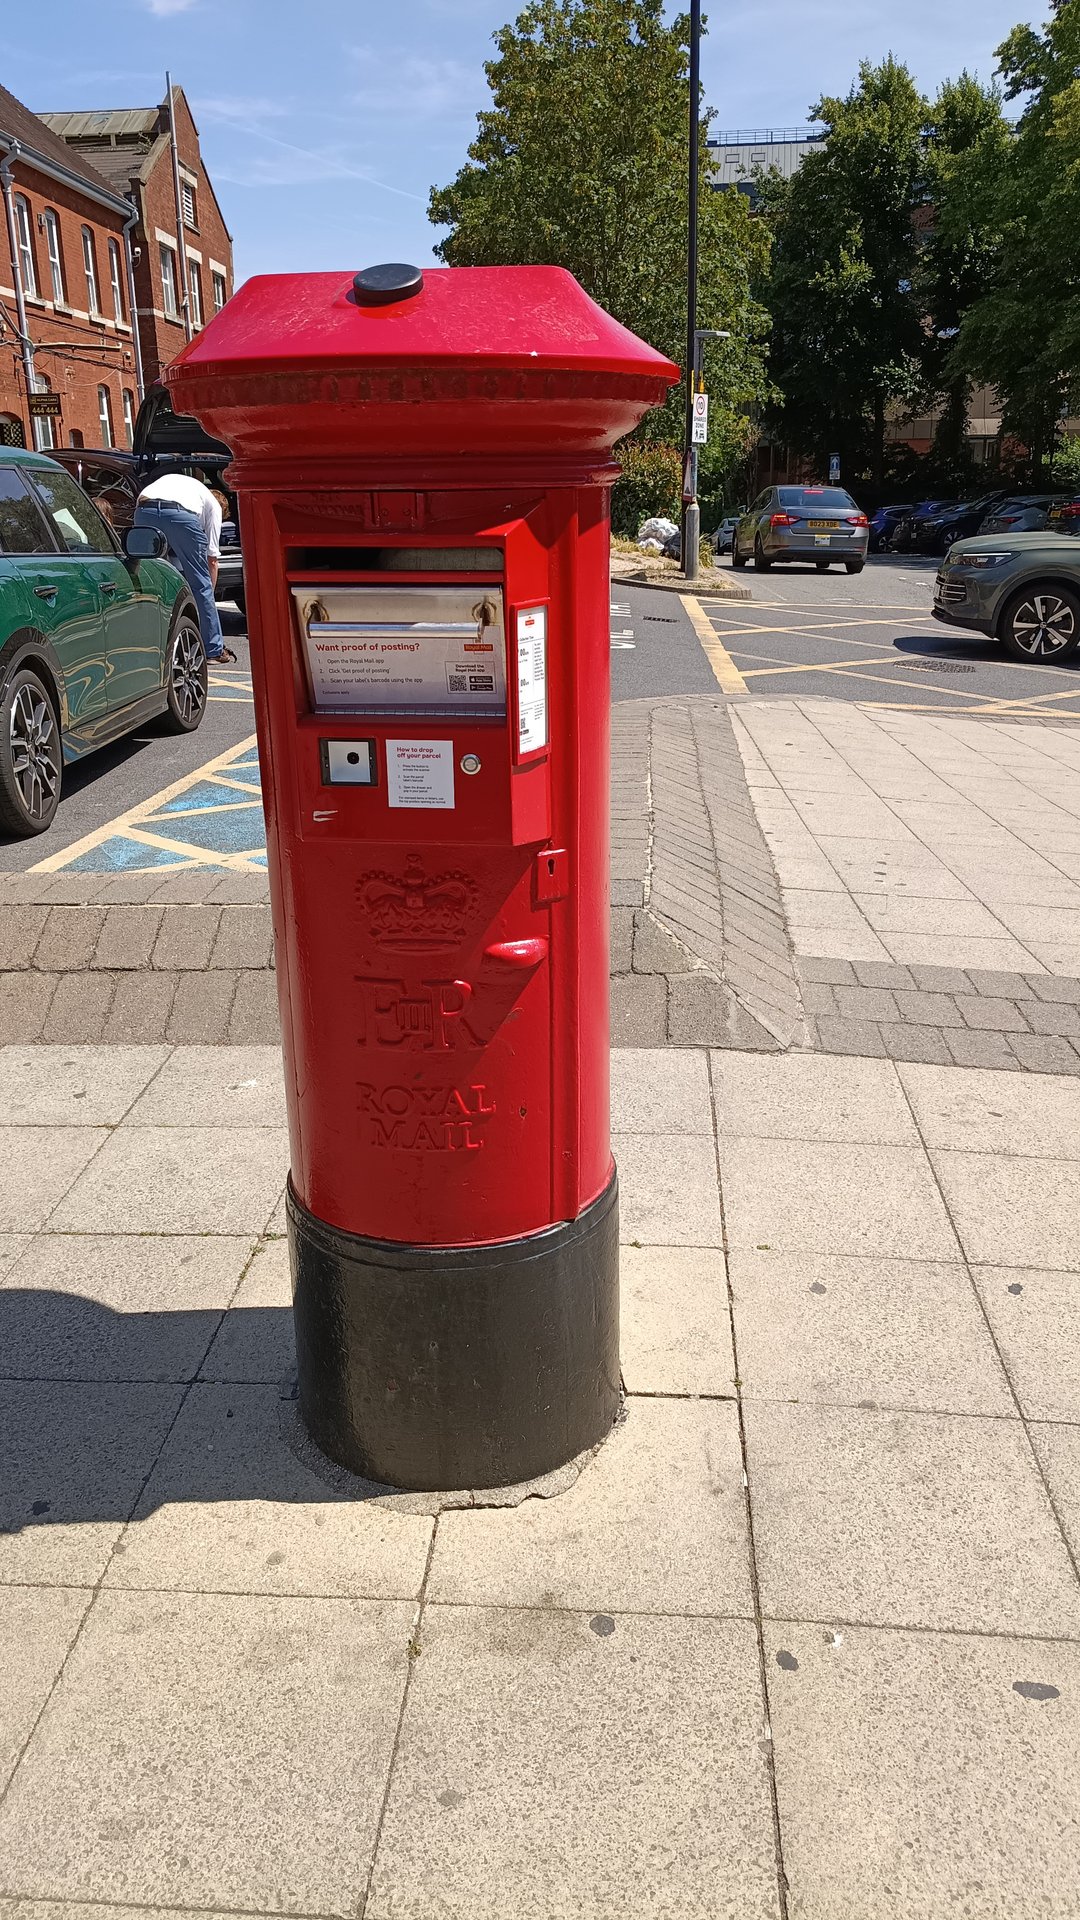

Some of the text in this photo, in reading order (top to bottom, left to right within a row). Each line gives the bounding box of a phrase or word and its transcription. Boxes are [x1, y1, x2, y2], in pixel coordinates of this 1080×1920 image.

[342, 643, 367, 652] proof
[381, 643, 420, 652] posting?
[355, 1081, 498, 1117] ROYAL
[369, 1117, 484, 1152] MAIL
